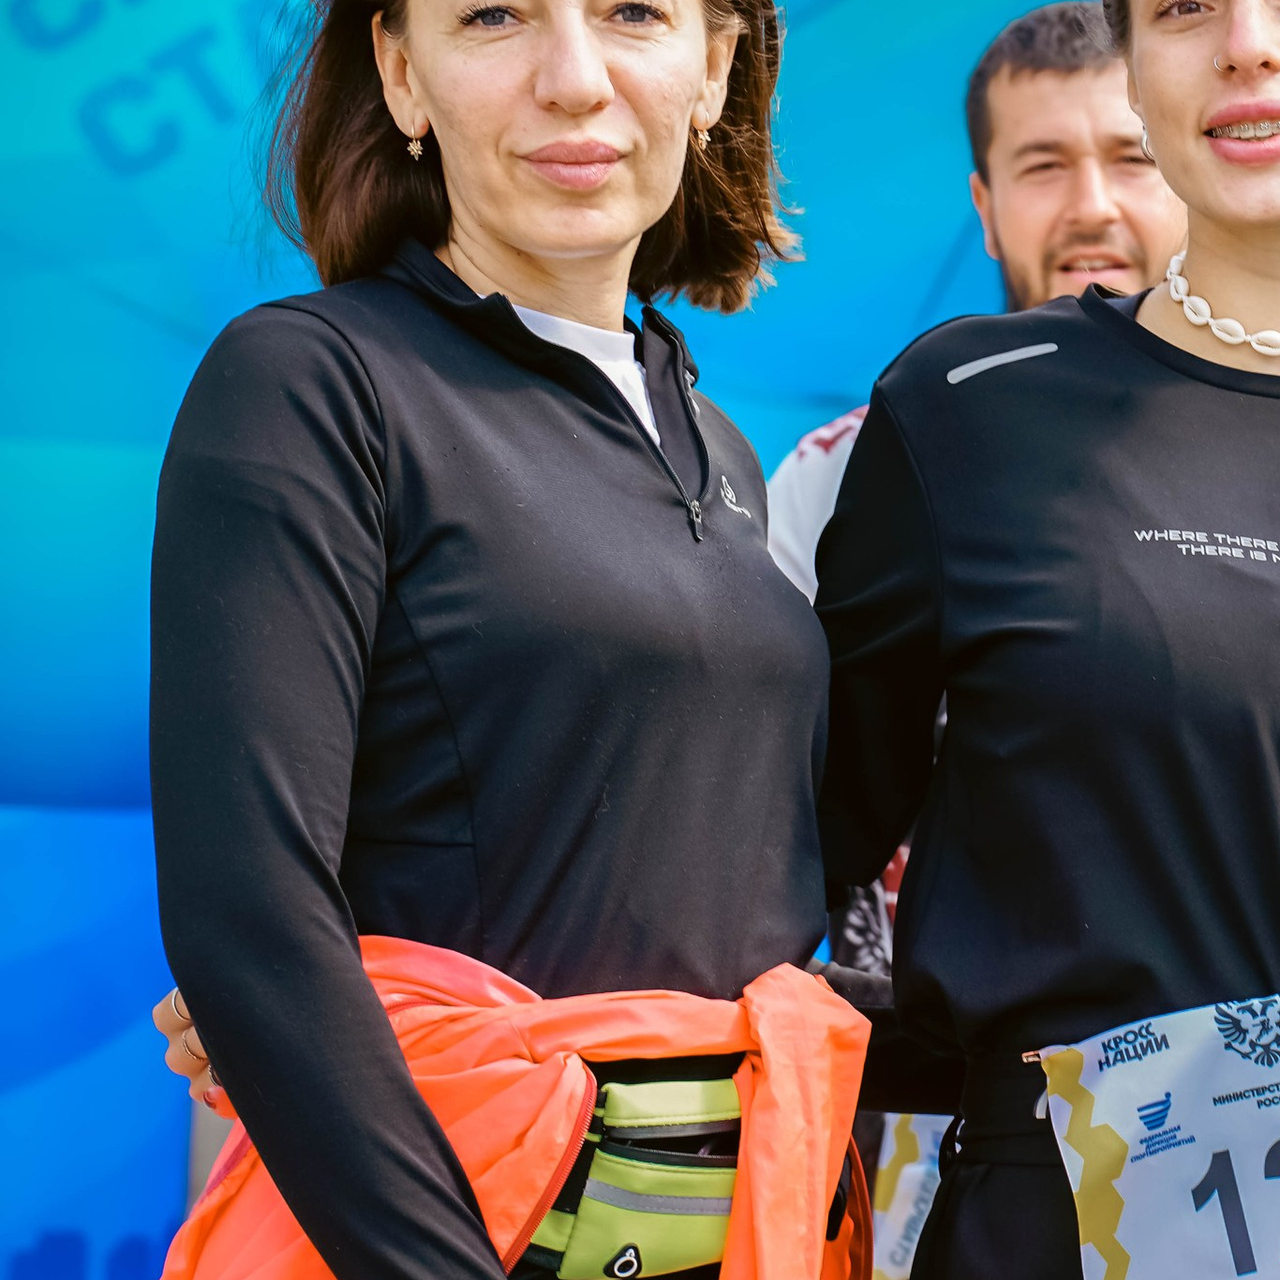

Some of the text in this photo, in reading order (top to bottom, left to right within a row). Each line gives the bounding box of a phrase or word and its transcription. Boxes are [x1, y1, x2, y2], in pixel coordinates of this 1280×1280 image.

[1134, 529, 1208, 542] WHERE
[1213, 533, 1279, 551] THERE
[1177, 544, 1244, 558] THERE
[1250, 550, 1267, 561] IS
[1101, 1021, 1156, 1054] КРОСС
[1098, 1033, 1170, 1072] НАЦИИ
